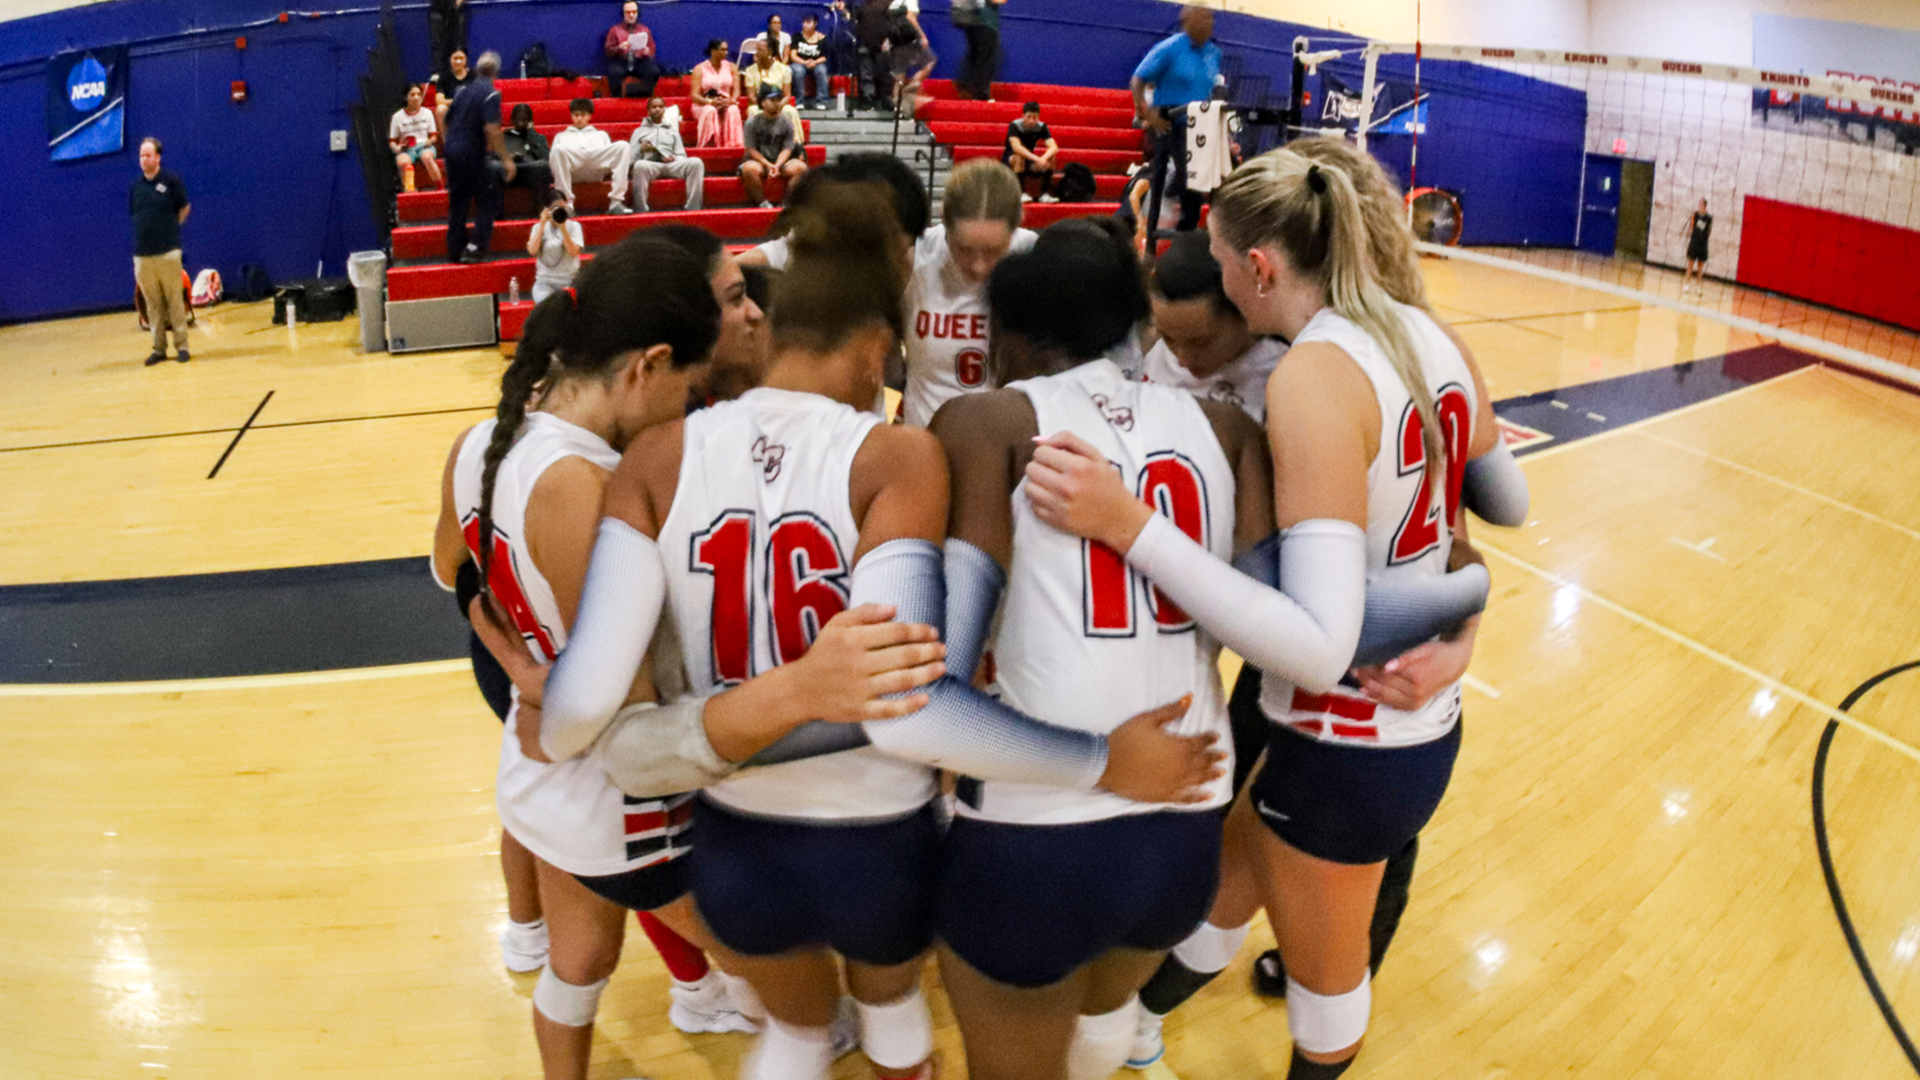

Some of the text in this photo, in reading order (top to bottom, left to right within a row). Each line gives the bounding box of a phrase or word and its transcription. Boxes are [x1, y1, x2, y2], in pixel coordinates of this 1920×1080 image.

[71, 81, 106, 101] NCAA
[1564, 52, 1608, 65] KNIGHTS
[1662, 60, 1703, 75] QUEENS
[1760, 71, 1810, 88] KNIGHTS
[1870, 86, 1915, 105] QUEENS
[915, 309, 988, 340] QUEE
[954, 347, 988, 389] 6
[1386, 381, 1471, 567] 20
[1082, 449, 1212, 638] 10
[688, 507, 851, 688] 16
